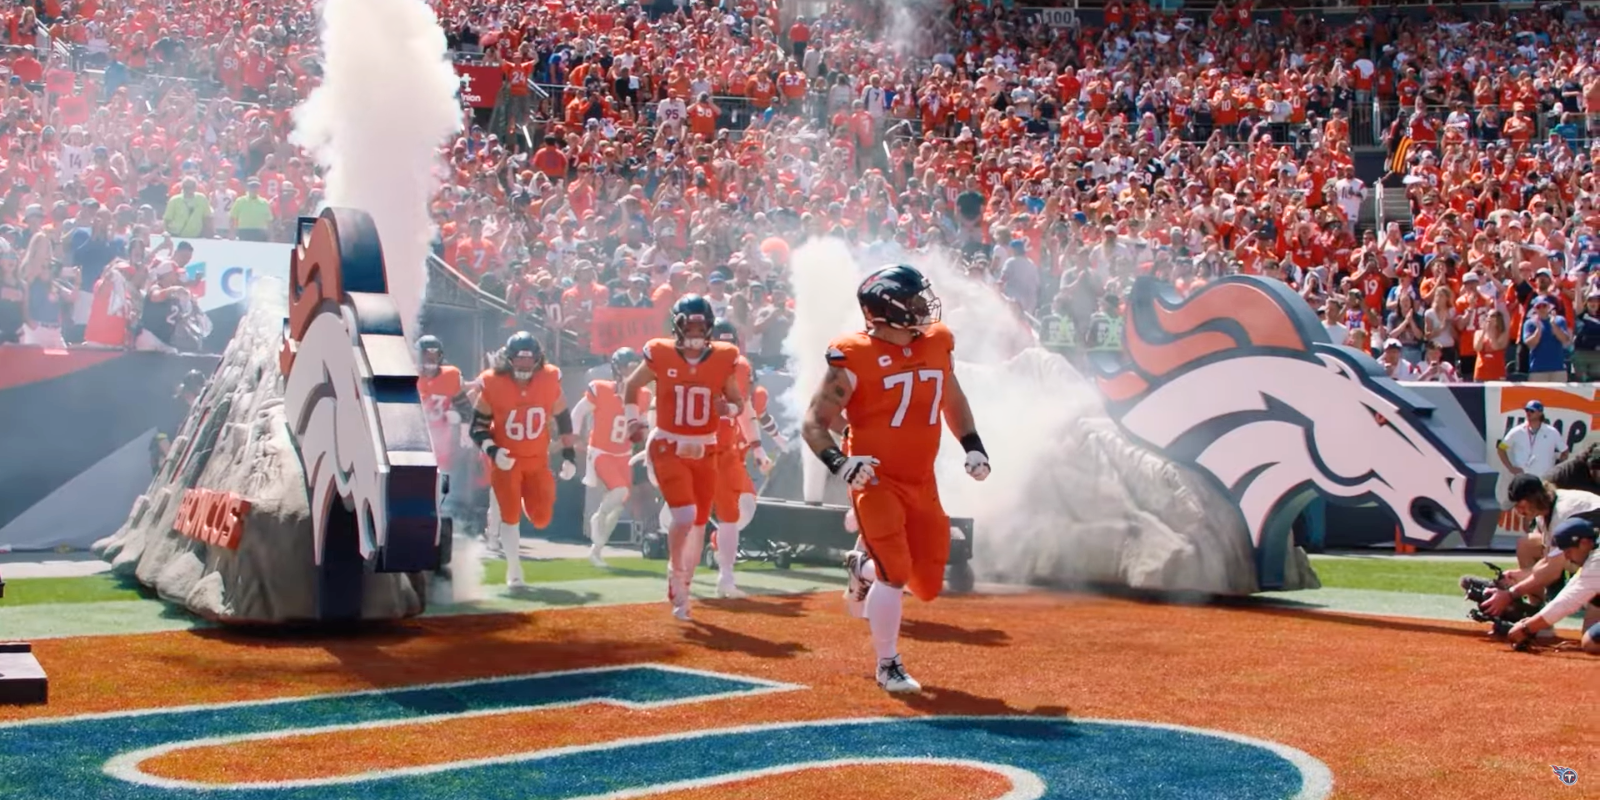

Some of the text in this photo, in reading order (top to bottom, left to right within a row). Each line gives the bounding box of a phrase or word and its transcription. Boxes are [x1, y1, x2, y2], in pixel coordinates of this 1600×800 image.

[1047, 11, 1072, 24] 100
[1238, 9, 1248, 19] 10
[1221, 99, 1231, 111] 10
[665, 109, 679, 121] 95
[69, 153, 82, 169] 14
[93, 176, 106, 193] 2
[473, 249, 486, 268] 7
[1364, 279, 1378, 295] 19
[166, 305, 179, 324] 2
[674, 385, 711, 427] 10
[883, 369, 944, 427] 77
[505, 407, 546, 441] 60
